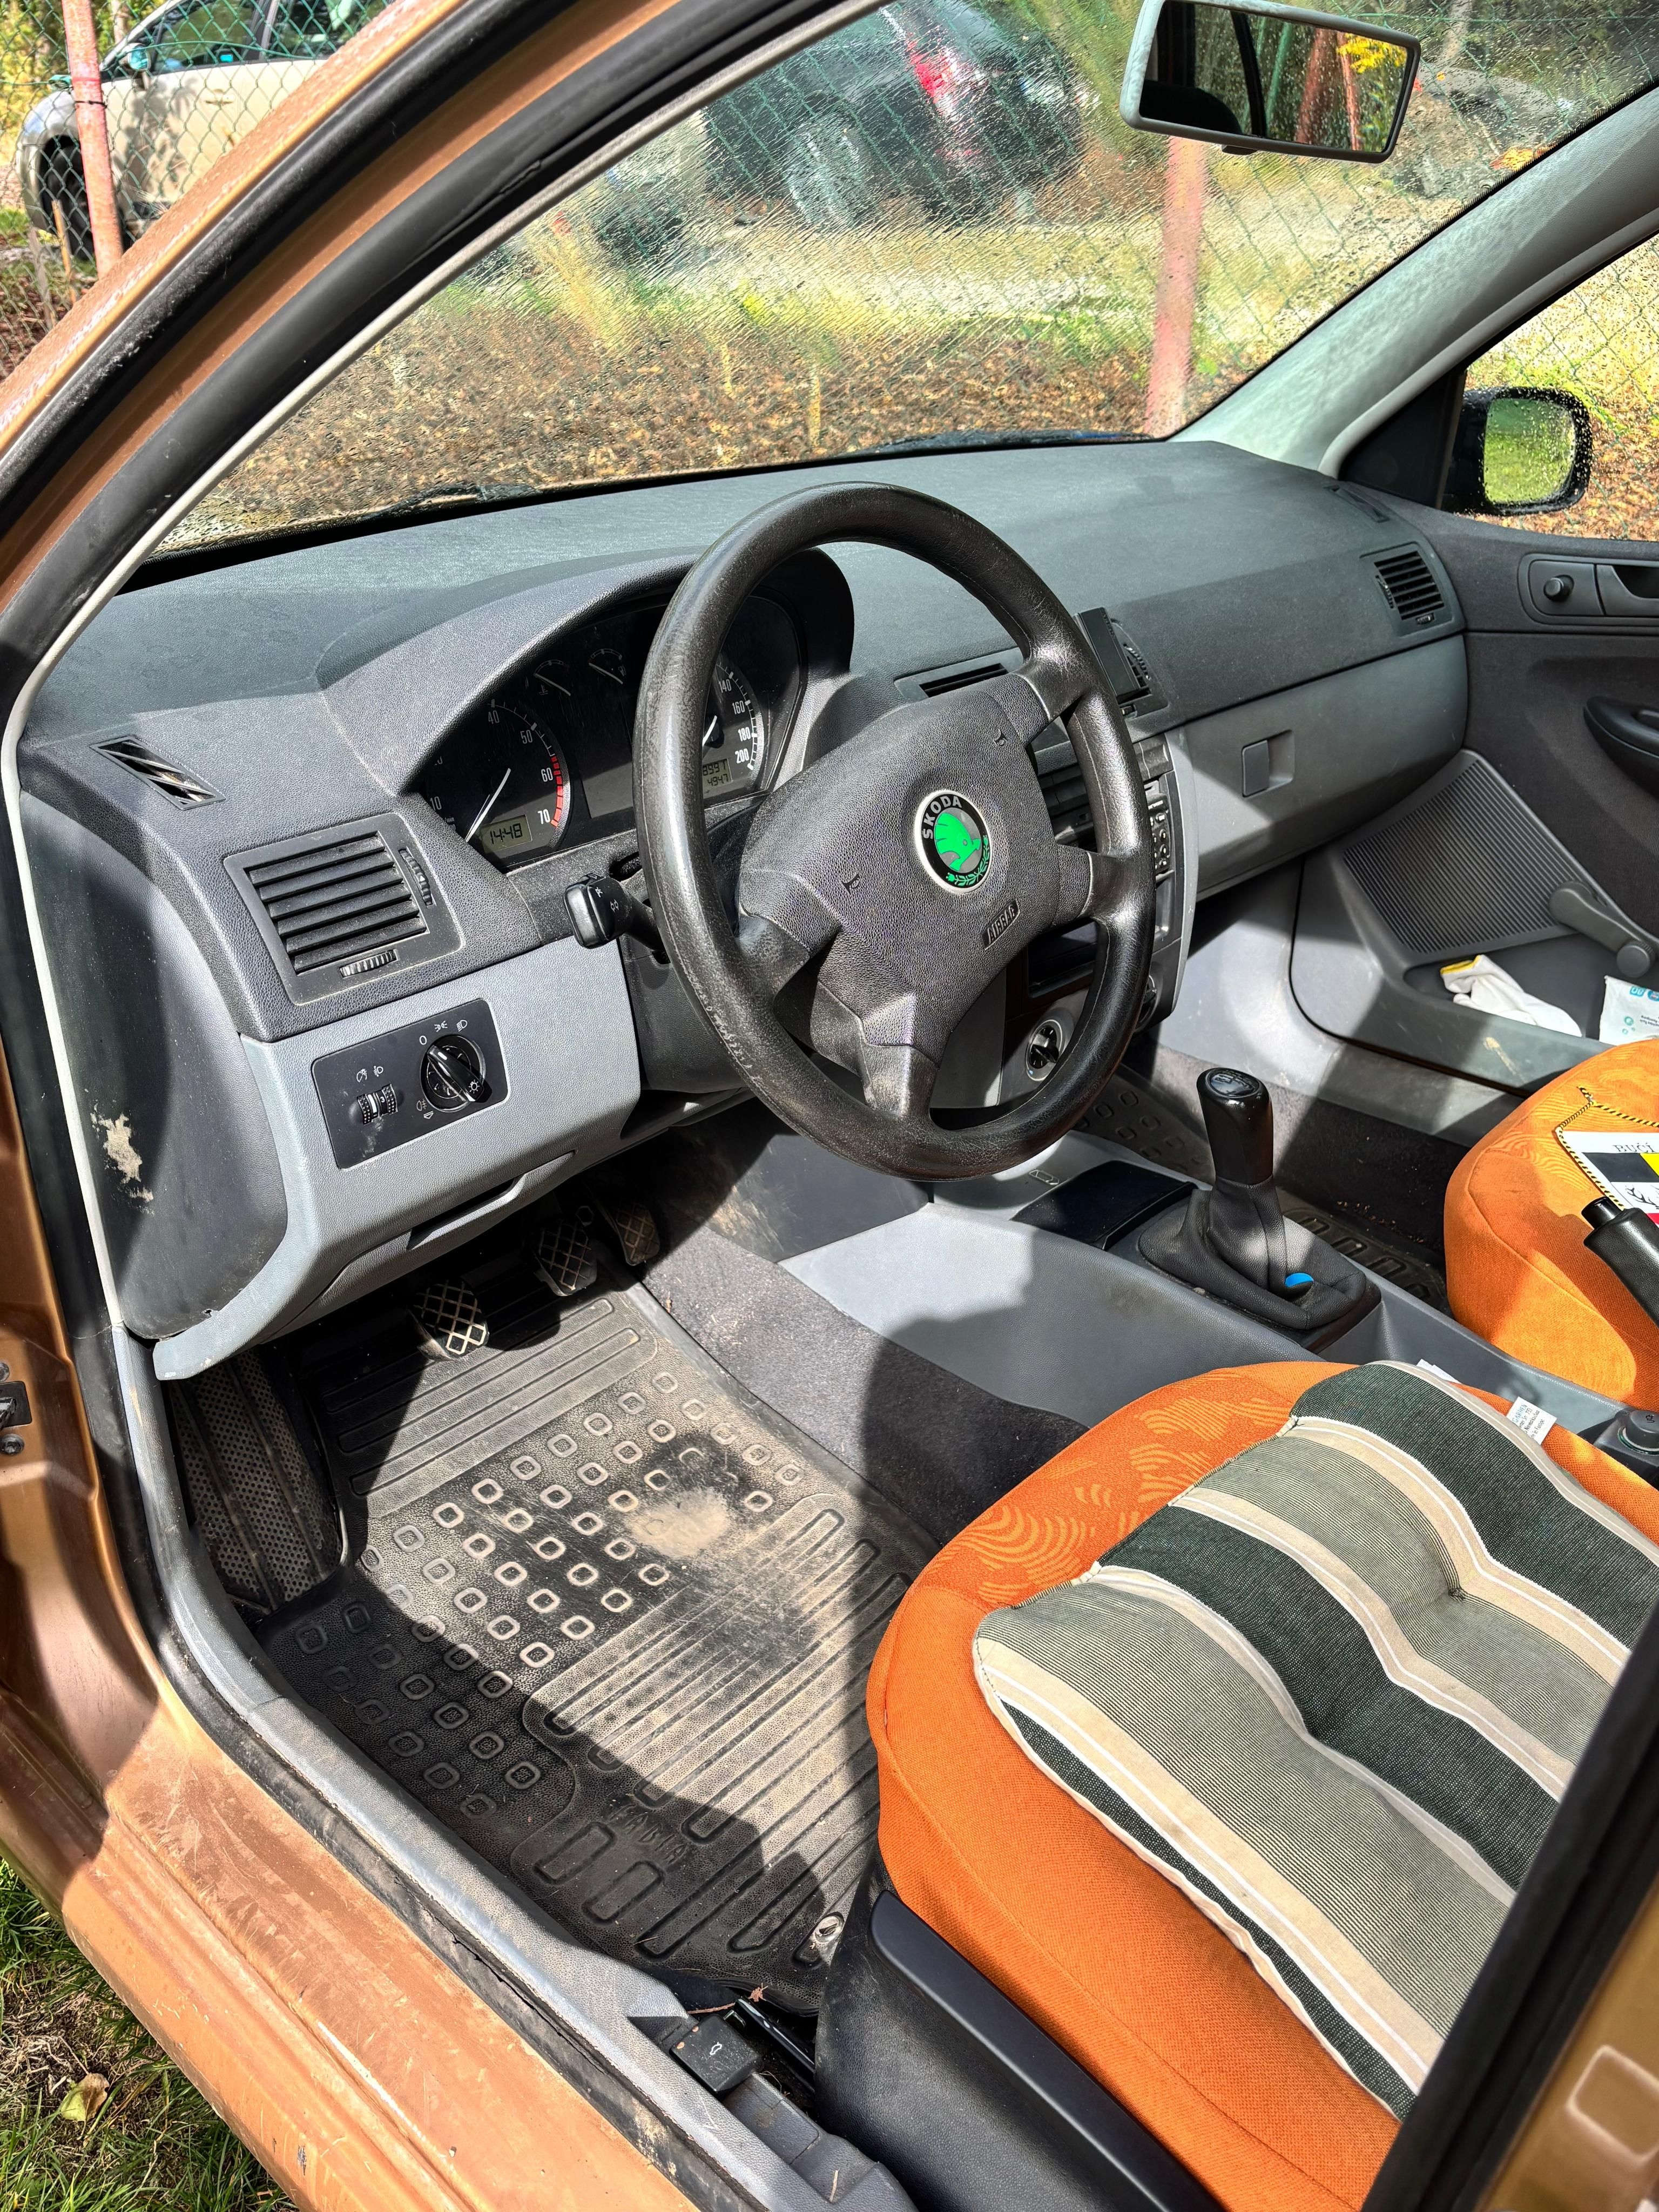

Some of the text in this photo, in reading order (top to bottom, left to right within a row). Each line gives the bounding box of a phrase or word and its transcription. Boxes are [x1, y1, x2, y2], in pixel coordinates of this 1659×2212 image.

[719, 679, 731, 693] 140
[732, 700, 745, 714] 160
[488, 710, 500, 724] 40
[520, 730, 533, 744] 50
[738, 727, 751, 742] 180
[735, 748, 750, 764] 200
[541, 767, 554, 782] 60
[430, 796, 442, 811] 10
[537, 809, 551, 825] 70
[490, 823, 523, 845] 14:48
[987, 904, 1016, 945] AIRBAG
